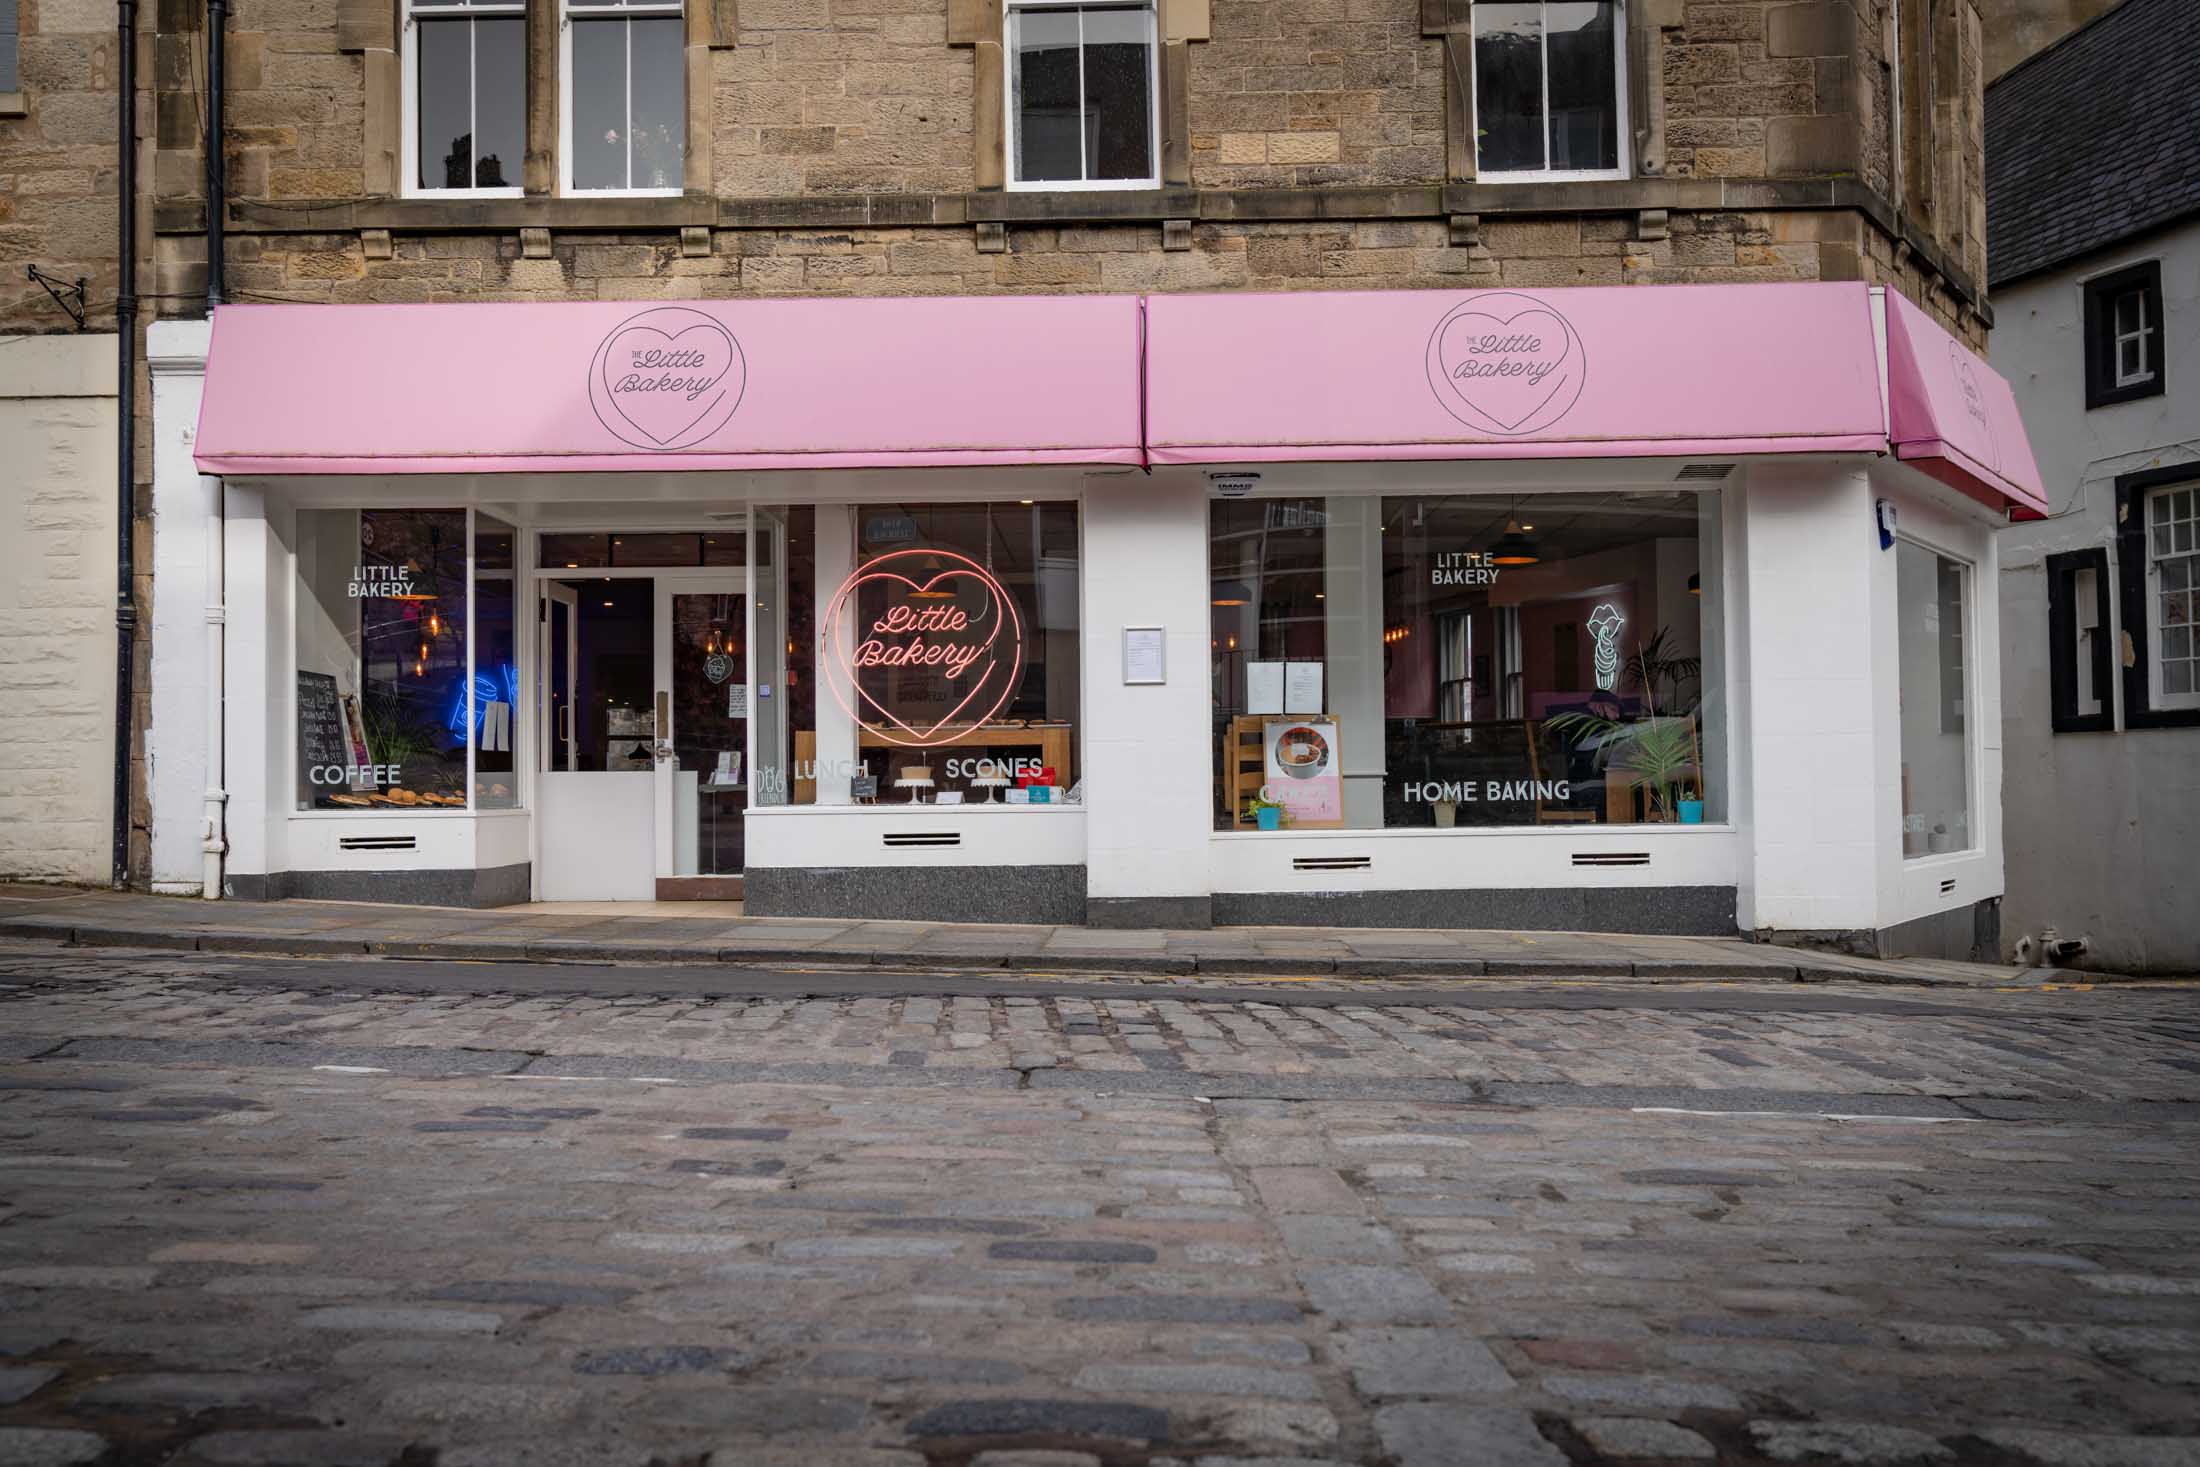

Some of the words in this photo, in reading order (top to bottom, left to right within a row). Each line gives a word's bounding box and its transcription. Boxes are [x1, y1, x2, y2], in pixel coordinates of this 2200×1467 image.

[1469, 334, 1541, 353] Little
[632, 350, 642, 359] THE
[633, 349, 705, 369] Little
[1453, 357, 1552, 386] Bakery
[614, 372, 712, 401] Bakery
[1437, 552, 1495, 568] LITTLE
[354, 566, 409, 580] LITTLE
[1431, 569, 1500, 585] BAKERY
[348, 582, 415, 598] BAKERY
[873, 605, 968, 633] Little
[852, 636, 983, 679] Bakery
[309, 764, 402, 785] COFFEE
[795, 760, 868, 779] LUNCH
[945, 757, 1043, 778] SCONES
[1404, 781, 1477, 802] HOME
[1486, 780, 1570, 801] BAKING
